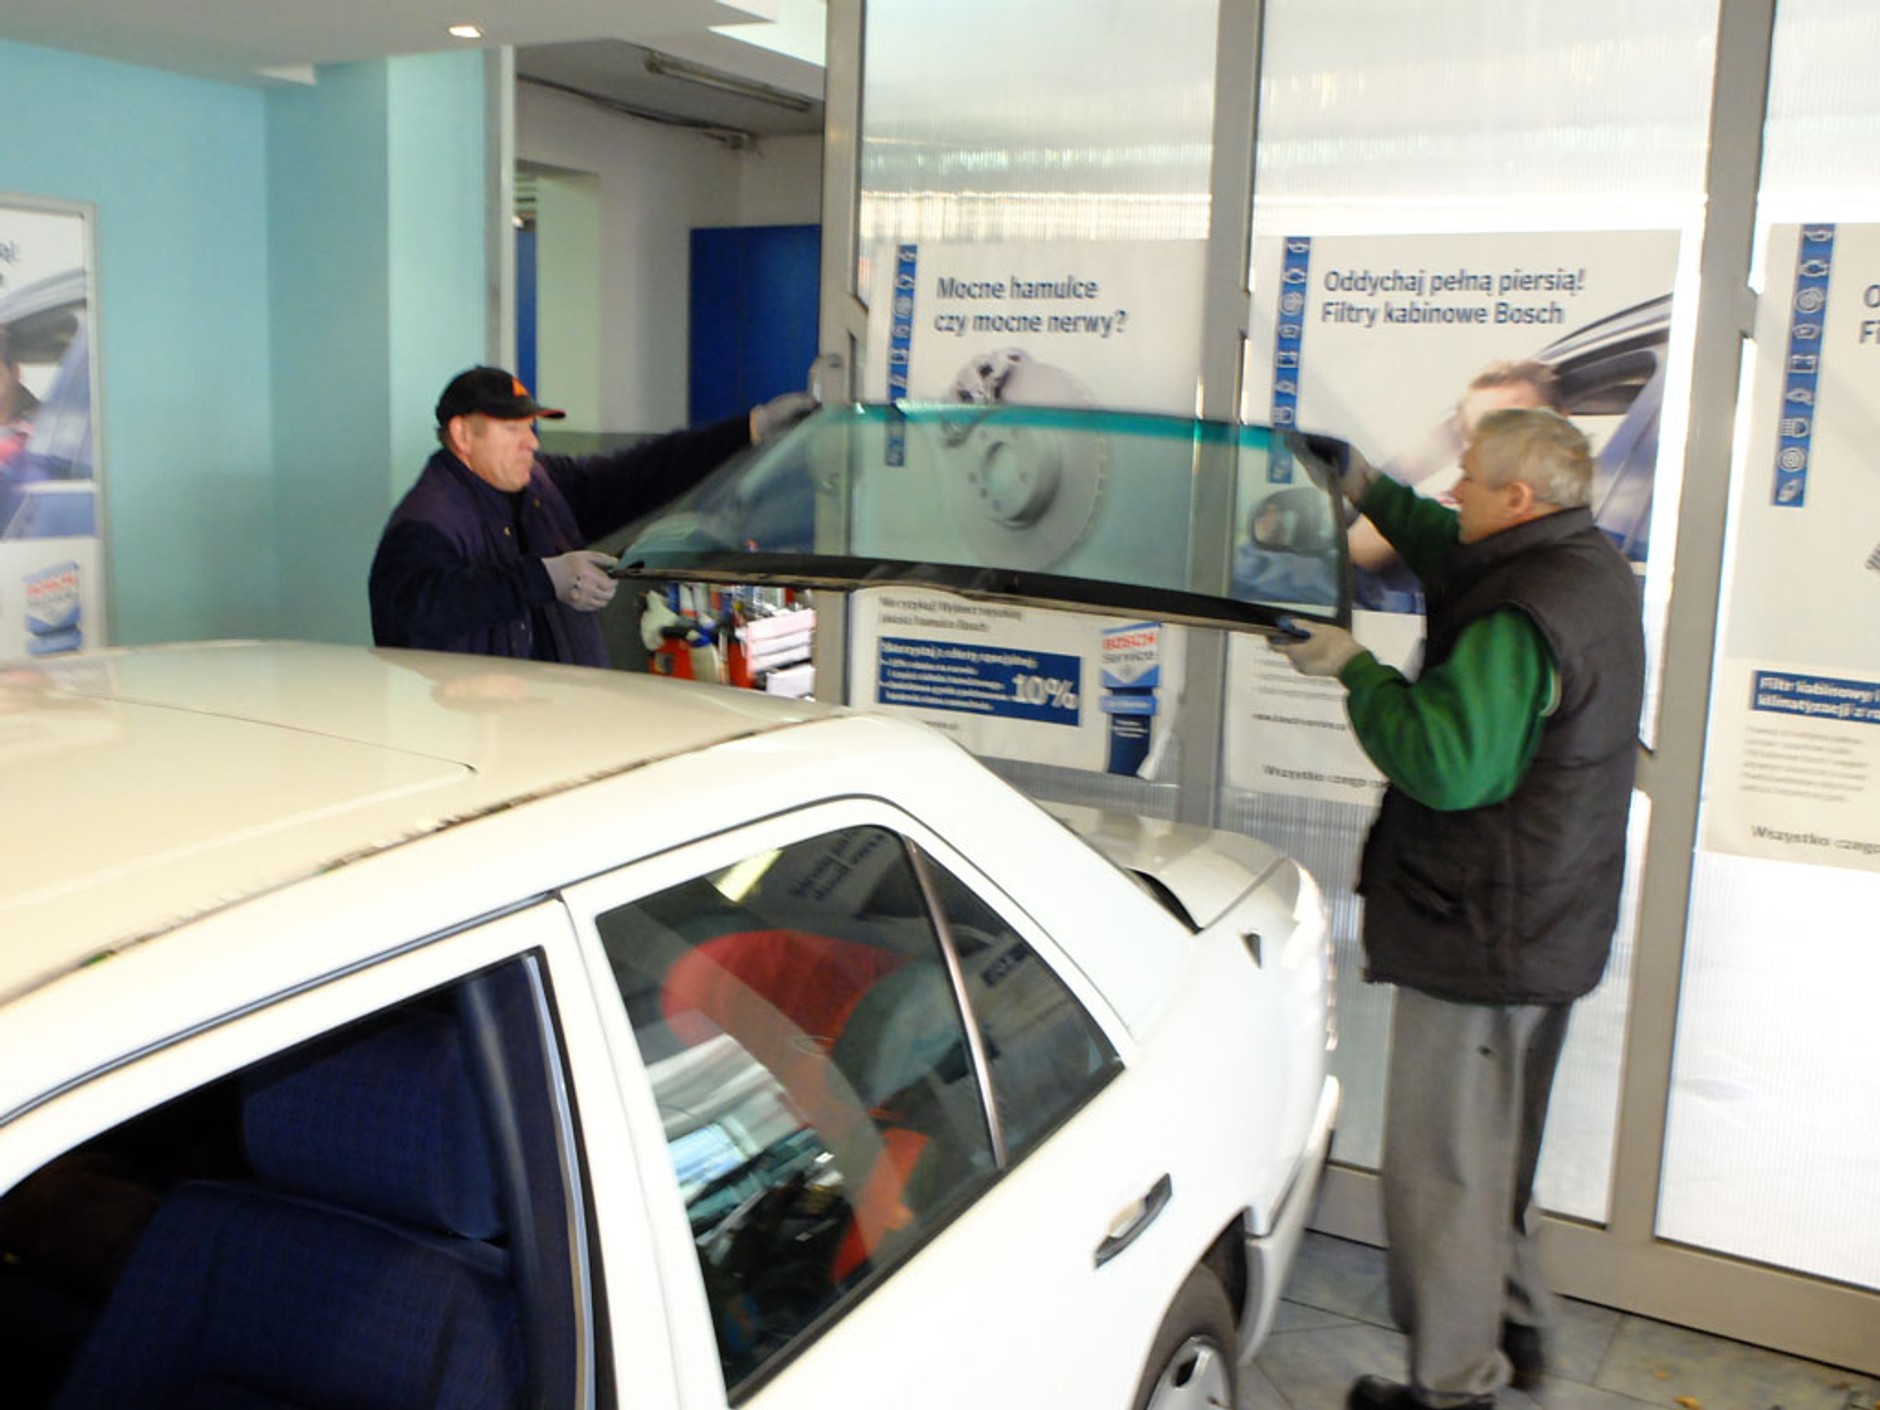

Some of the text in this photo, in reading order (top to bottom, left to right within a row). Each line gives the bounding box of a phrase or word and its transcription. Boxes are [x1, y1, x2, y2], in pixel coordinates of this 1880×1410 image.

[936, 275, 1099, 299] Mocne hamulce
[1324, 268, 1587, 297] Oddychaj pełną piersią!
[934, 310, 1127, 338] czy mocne nerwy?
[1321, 301, 1566, 328] Filtry kabinowe Bosch
[1012, 673, 1079, 710] 10%
[1751, 825, 1830, 847] Wszystko
